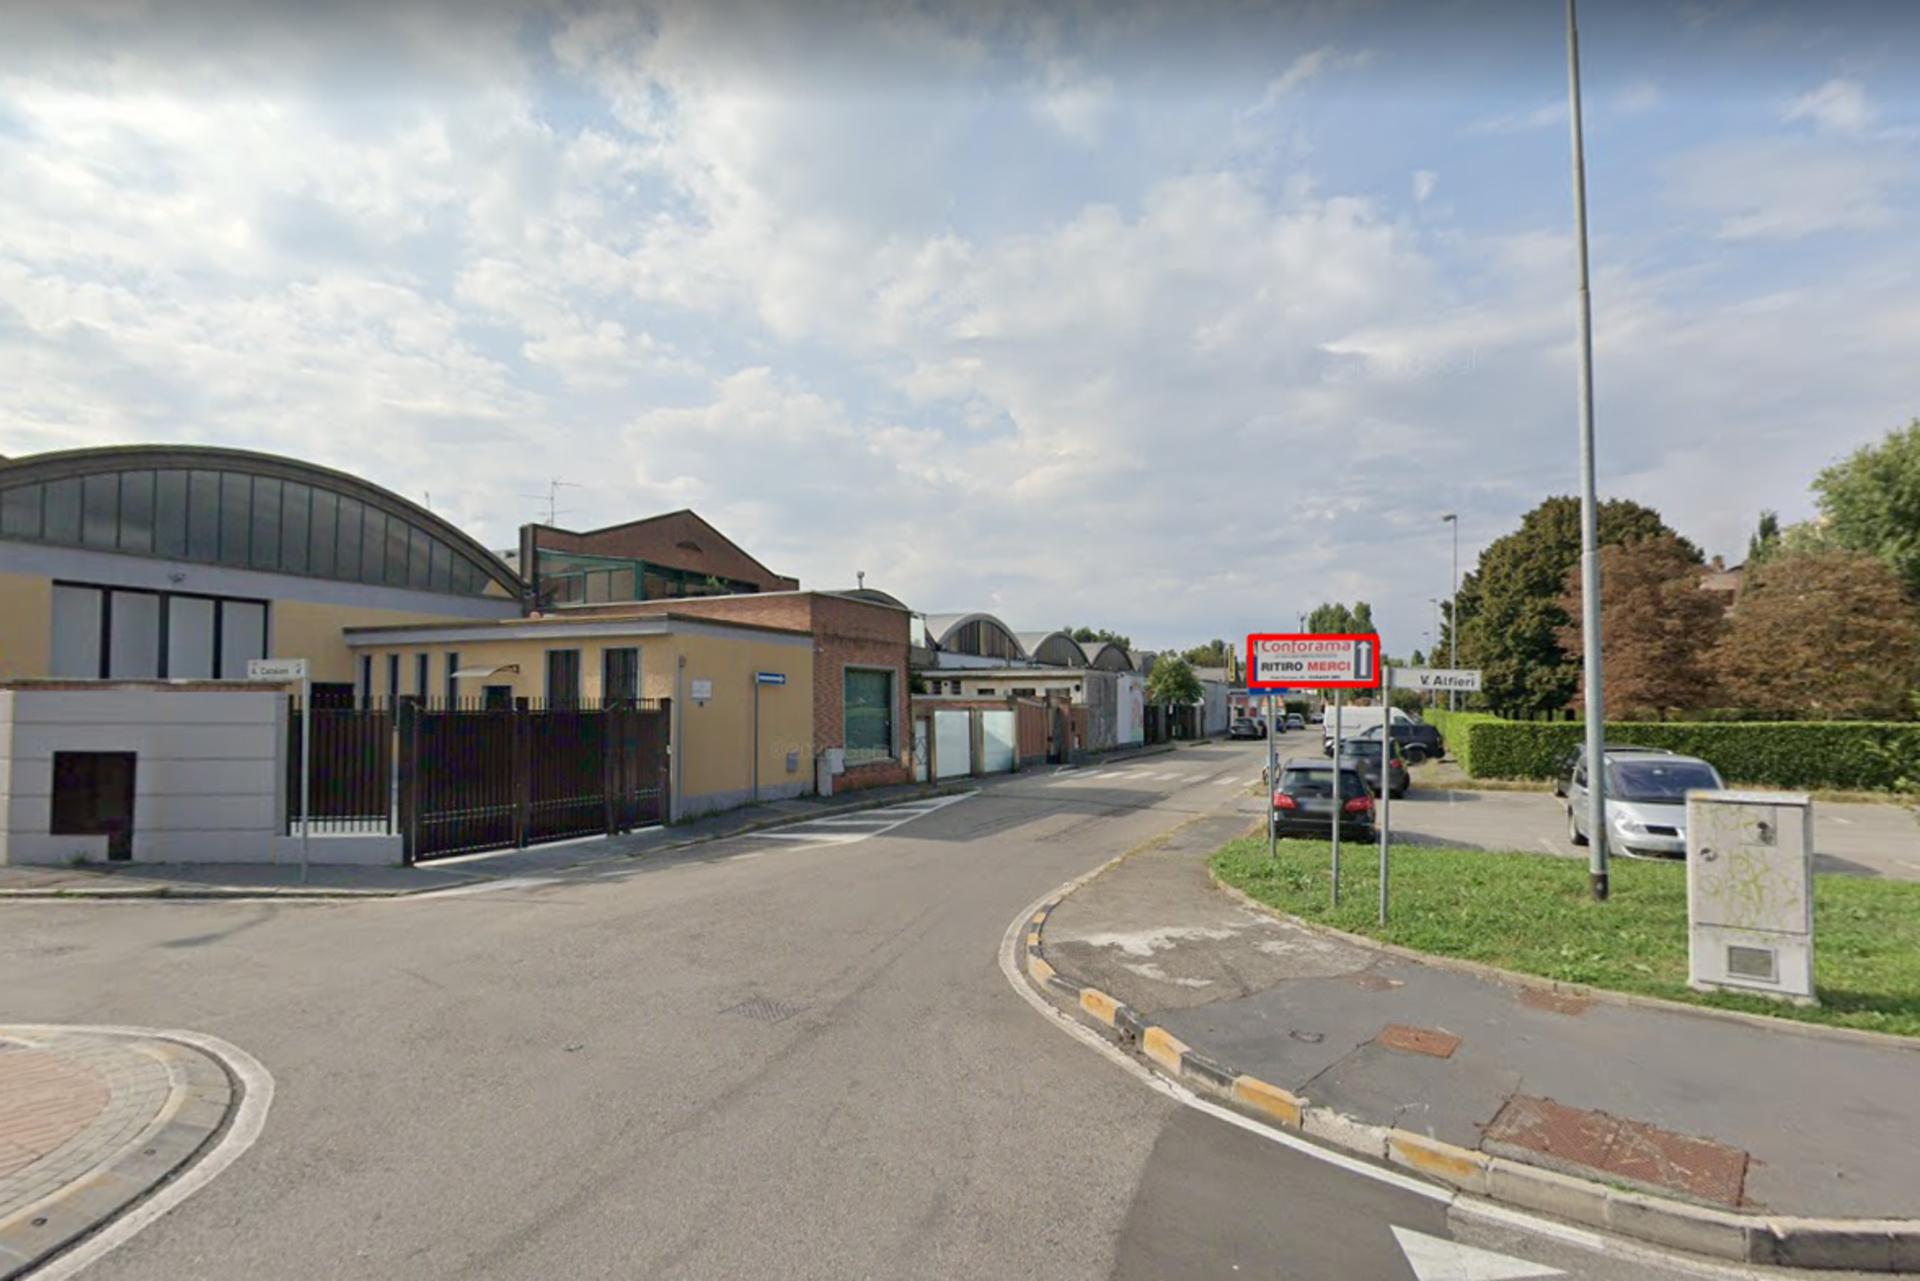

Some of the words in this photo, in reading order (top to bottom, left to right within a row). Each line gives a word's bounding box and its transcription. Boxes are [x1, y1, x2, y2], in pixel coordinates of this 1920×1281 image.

[1262, 640, 1351, 653] Conforama
[1261, 662, 1303, 671] RITIRO
[1307, 662, 1350, 671] MERCI
[1433, 675, 1475, 687] Alfieri
